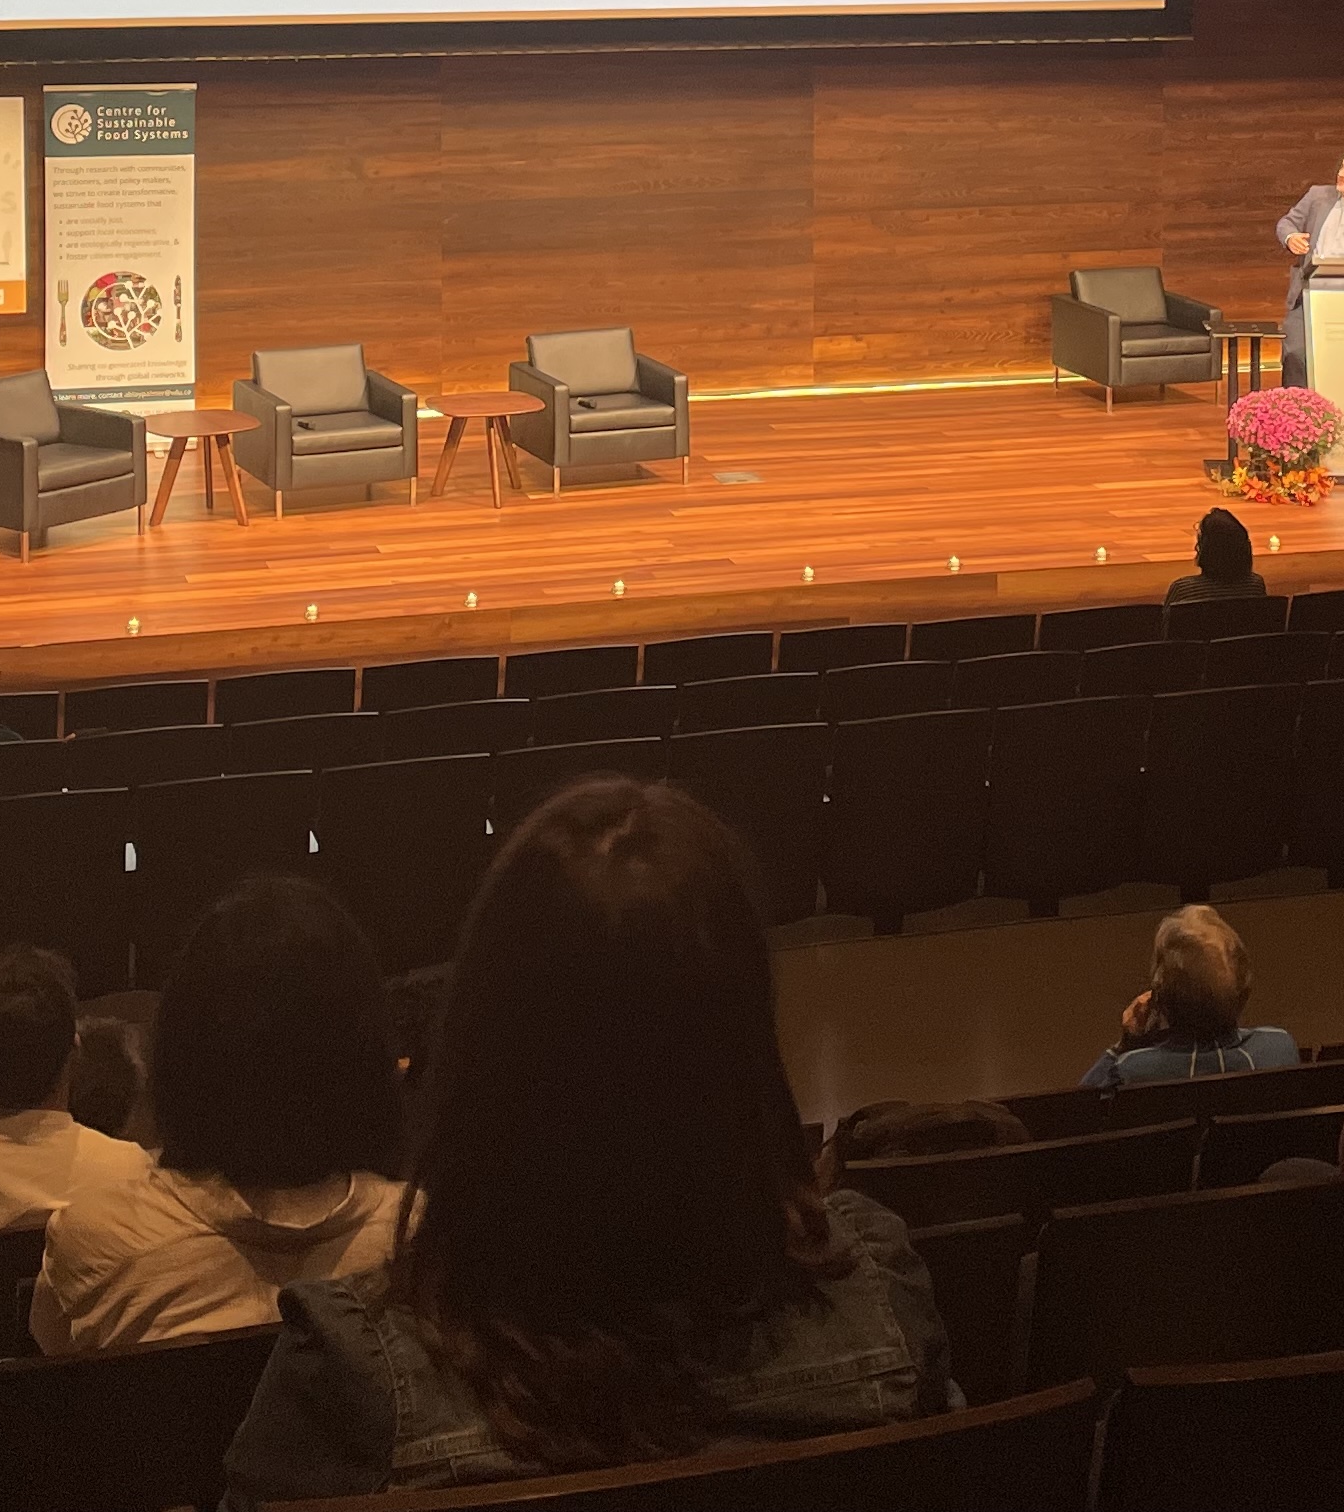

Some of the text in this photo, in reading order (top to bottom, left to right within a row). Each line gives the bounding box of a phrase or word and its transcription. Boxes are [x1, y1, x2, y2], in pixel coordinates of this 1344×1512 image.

[97, 104, 167, 117] Centre for
[97, 117, 176, 129] Sustainable
[97, 129, 189, 143] Food Systems
